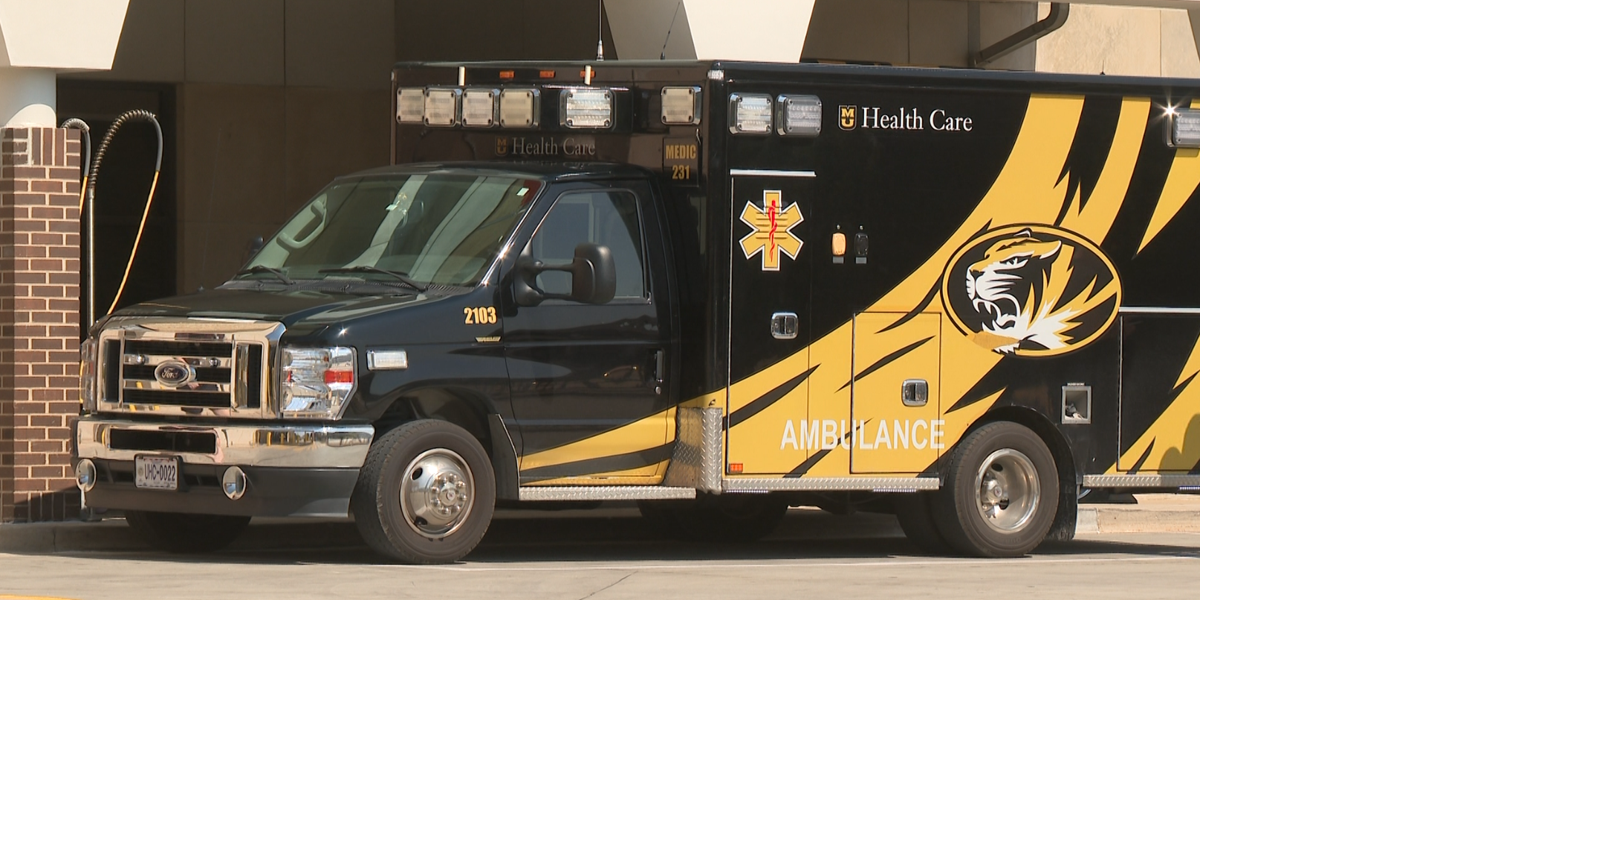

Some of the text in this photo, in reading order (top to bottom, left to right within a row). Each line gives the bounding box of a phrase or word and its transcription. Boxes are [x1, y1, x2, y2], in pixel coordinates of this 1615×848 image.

[861, 106, 924, 130] Health
[929, 109, 973, 132] Care
[512, 136, 558, 156] Health
[562, 137, 596, 156] Care
[665, 144, 697, 160] MEDIC
[672, 164, 690, 180] 231
[463, 306, 497, 325] 2103
[780, 419, 946, 451] AMBULANCE
[144, 463, 176, 482] UHC-0022
